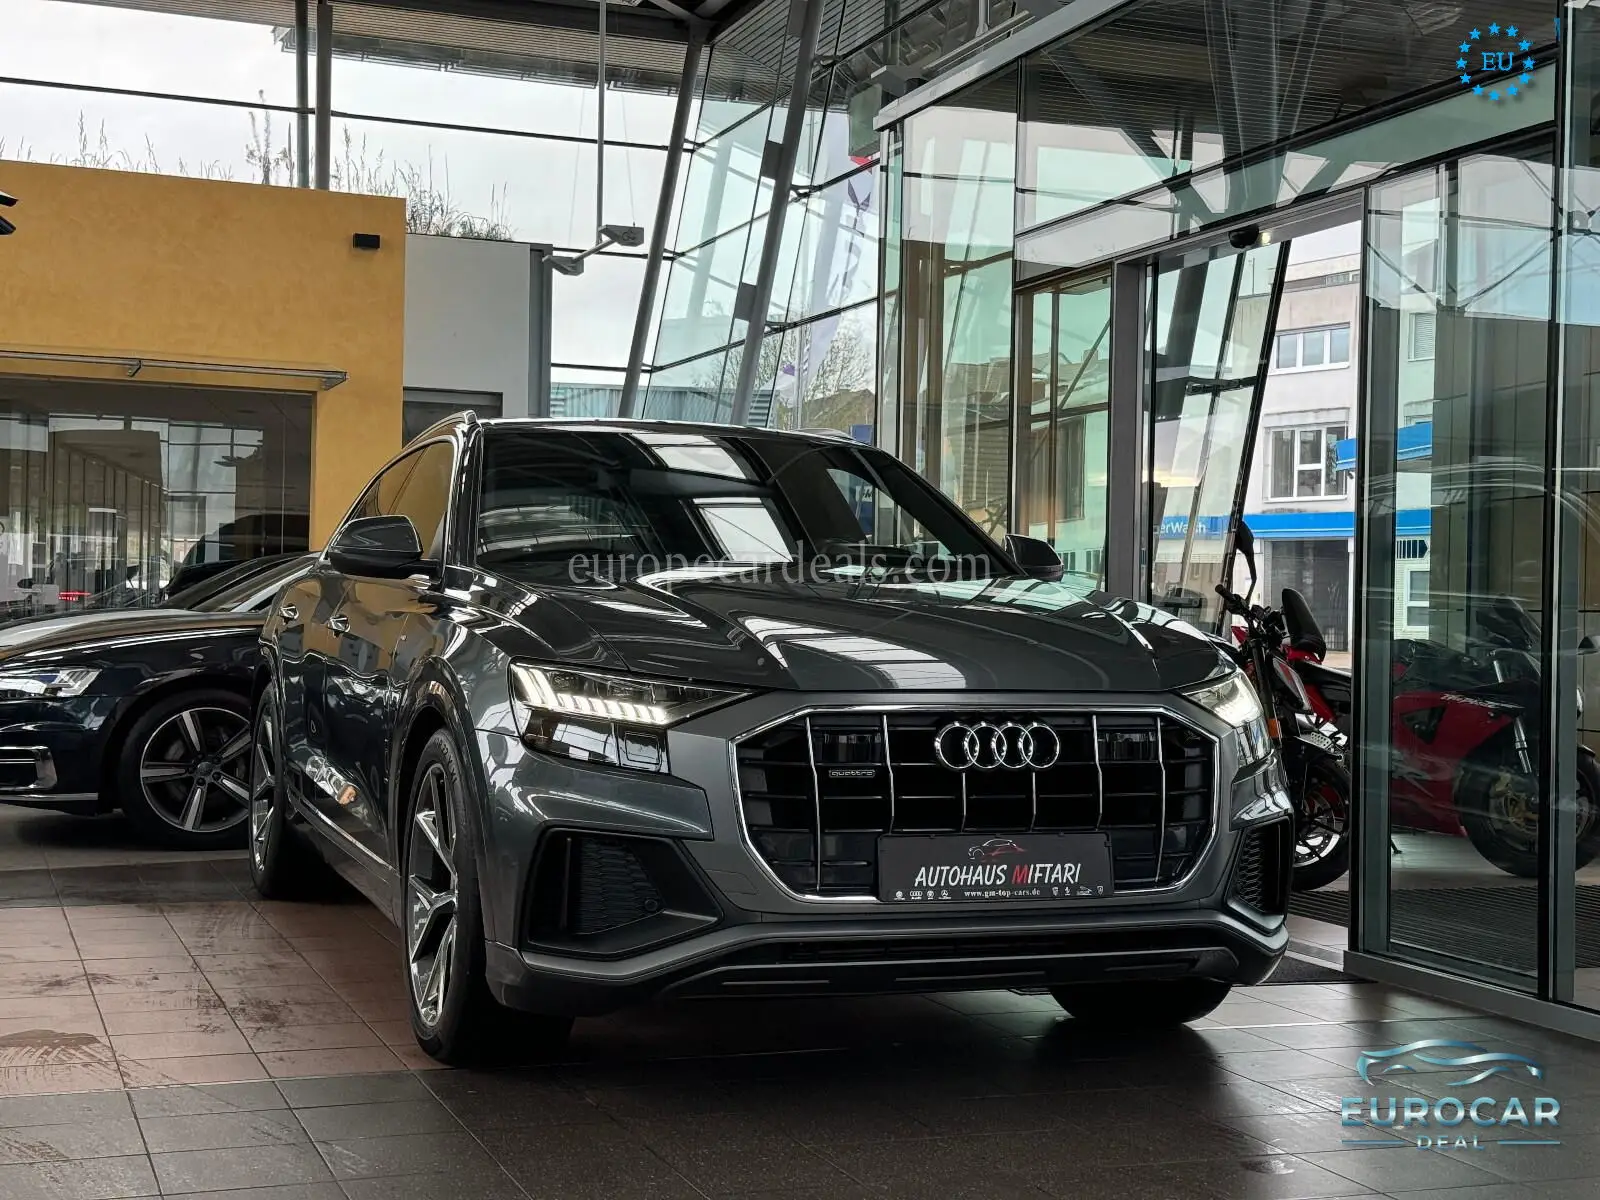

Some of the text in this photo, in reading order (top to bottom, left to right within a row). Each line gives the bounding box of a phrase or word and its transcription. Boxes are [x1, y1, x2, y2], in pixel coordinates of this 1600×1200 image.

[914, 863, 1081, 887] AUTOHAUS MIFTARI
[964, 889, 1041, 898] www.gm-top-cars.de
